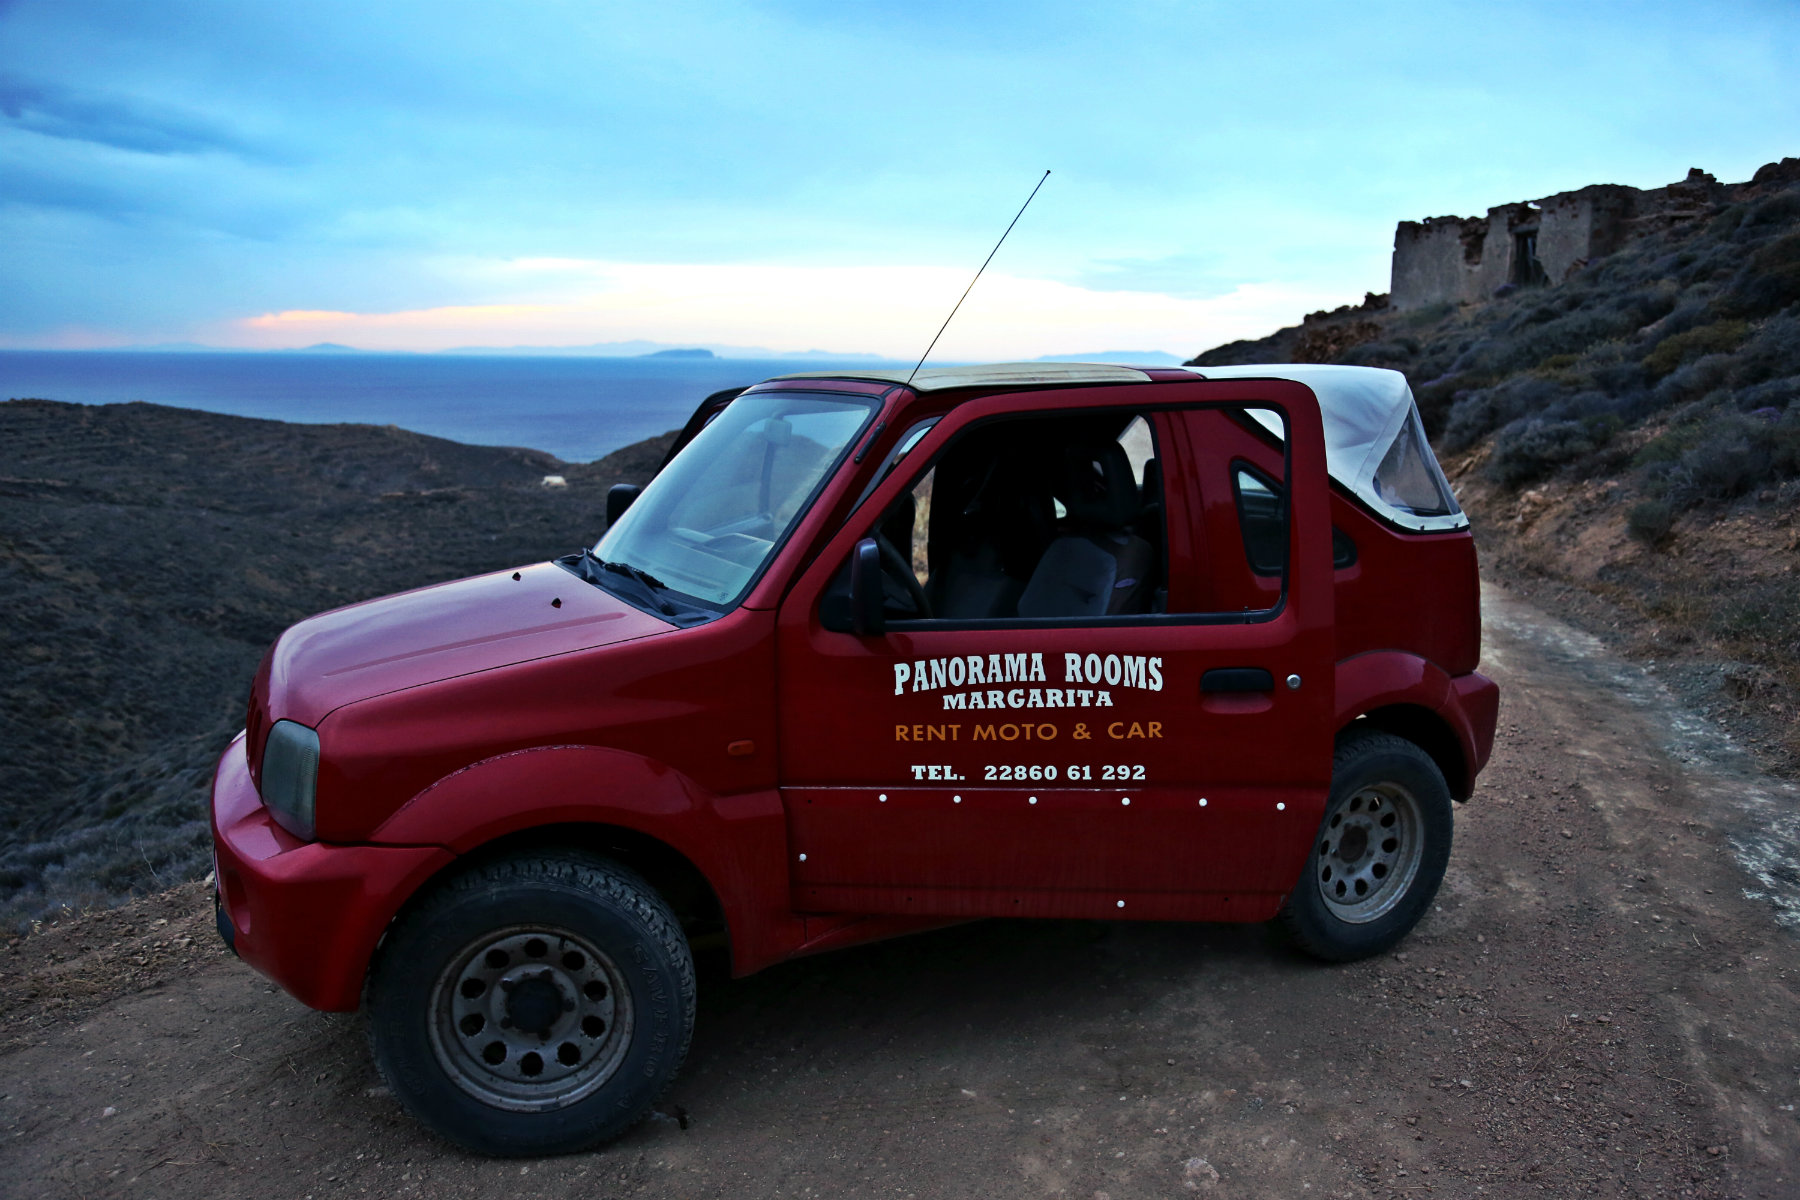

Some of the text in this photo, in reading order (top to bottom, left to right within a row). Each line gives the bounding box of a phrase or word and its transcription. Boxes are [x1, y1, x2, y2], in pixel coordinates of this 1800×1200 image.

[894, 653, 1163, 695] PANORAMA ROOMS
[943, 689, 1113, 709] MARGARITA
[896, 722, 1162, 741] RENT MOTO & CAR
[911, 765, 1145, 780] TEL. 22860 61 292
